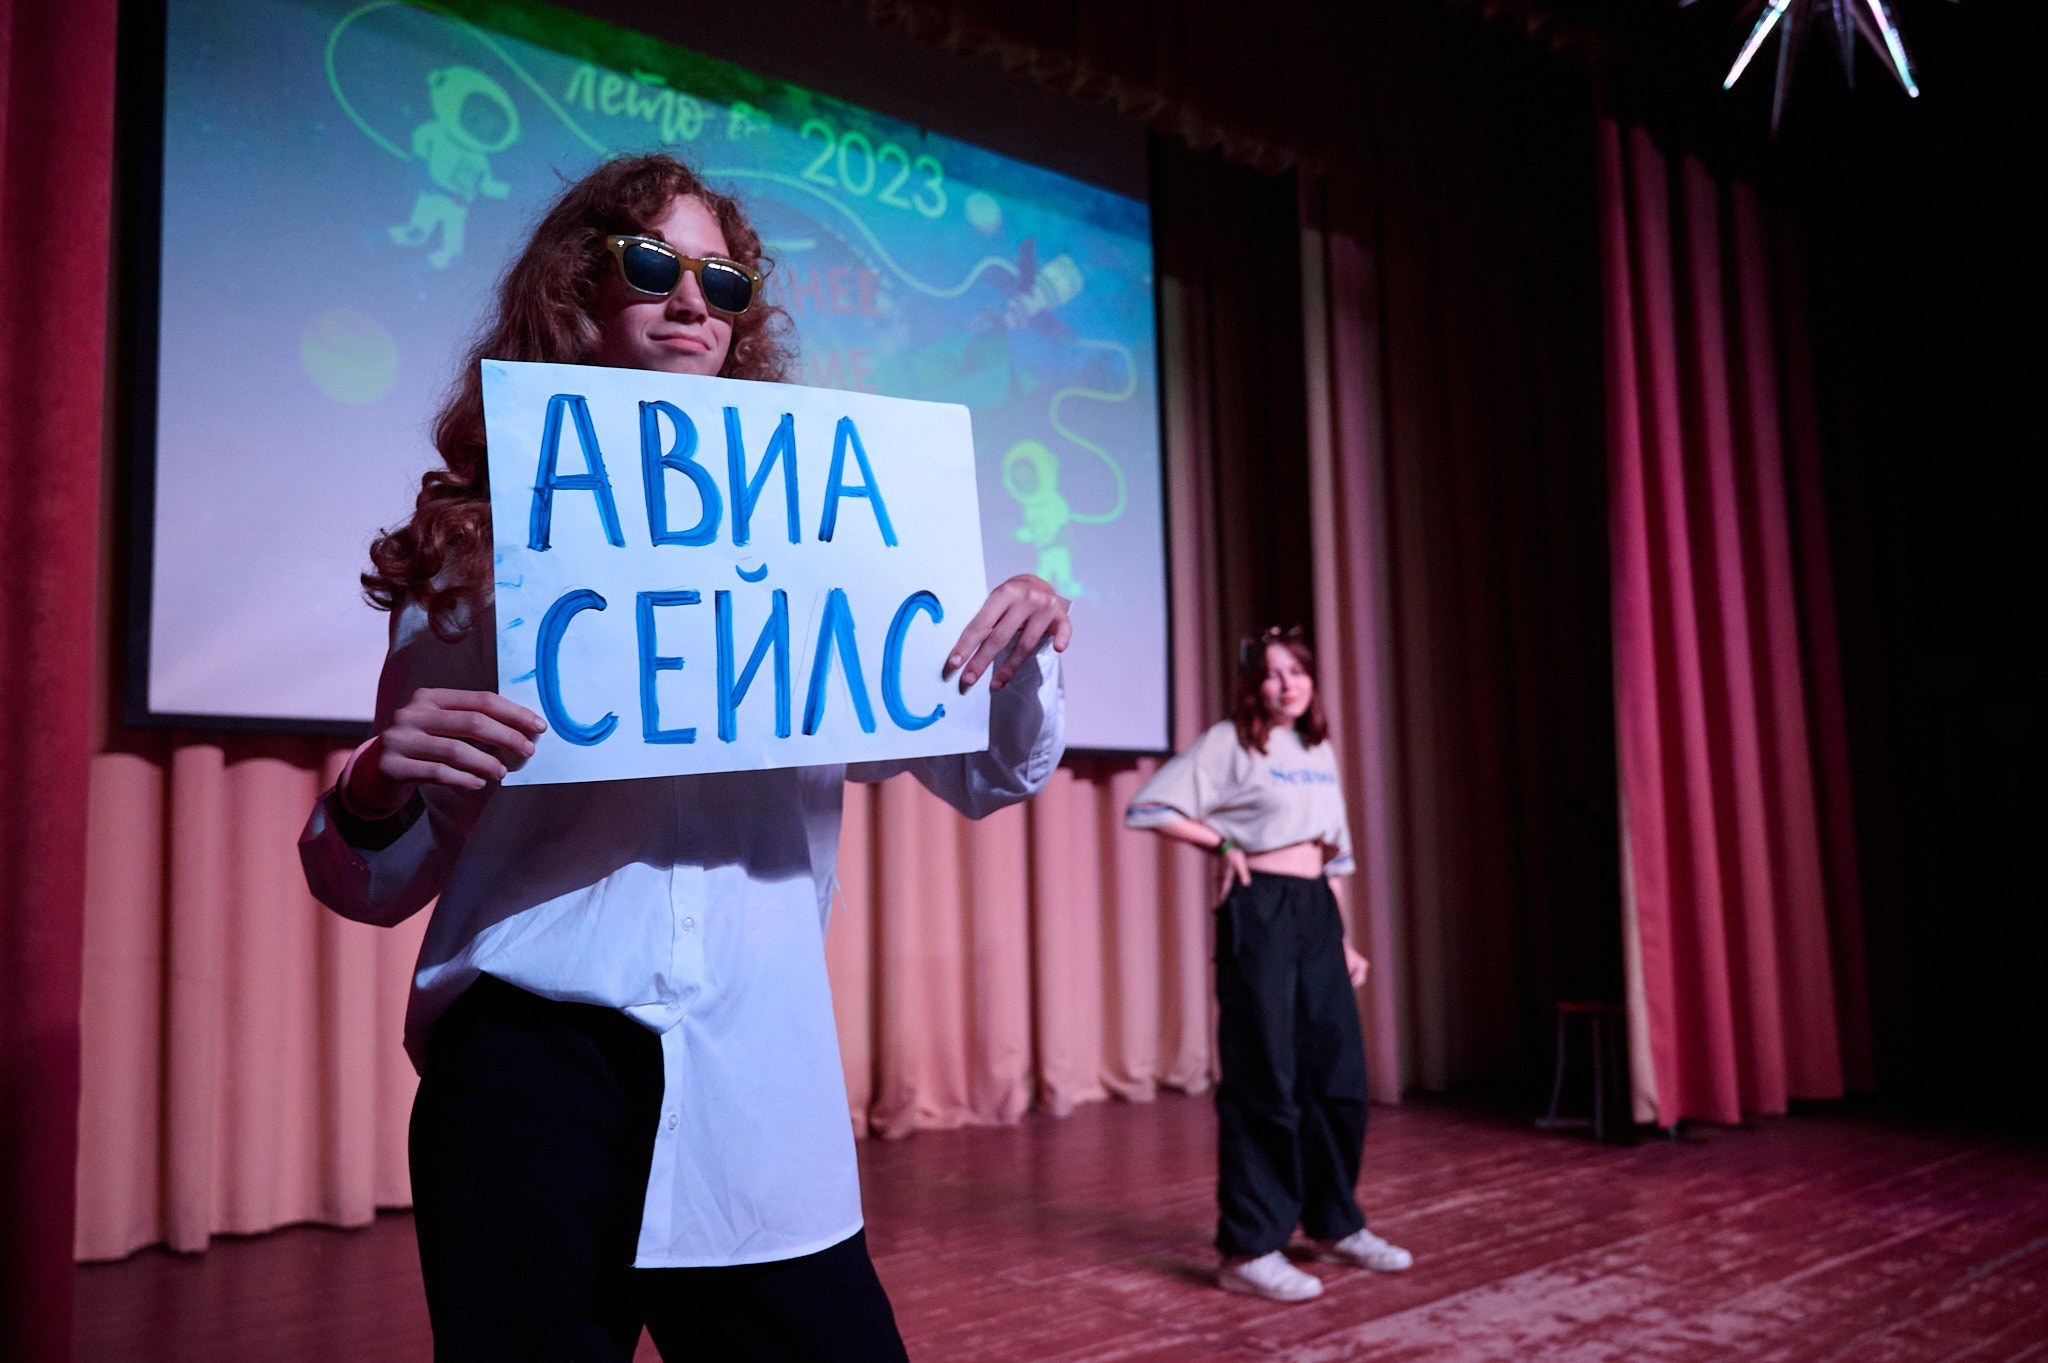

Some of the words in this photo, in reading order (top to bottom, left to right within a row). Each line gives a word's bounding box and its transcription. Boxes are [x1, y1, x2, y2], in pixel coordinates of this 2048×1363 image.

[801, 118, 948, 218] 2023
[528, 393, 899, 551] АВИА
[535, 562, 946, 746] СЕЙЛС
